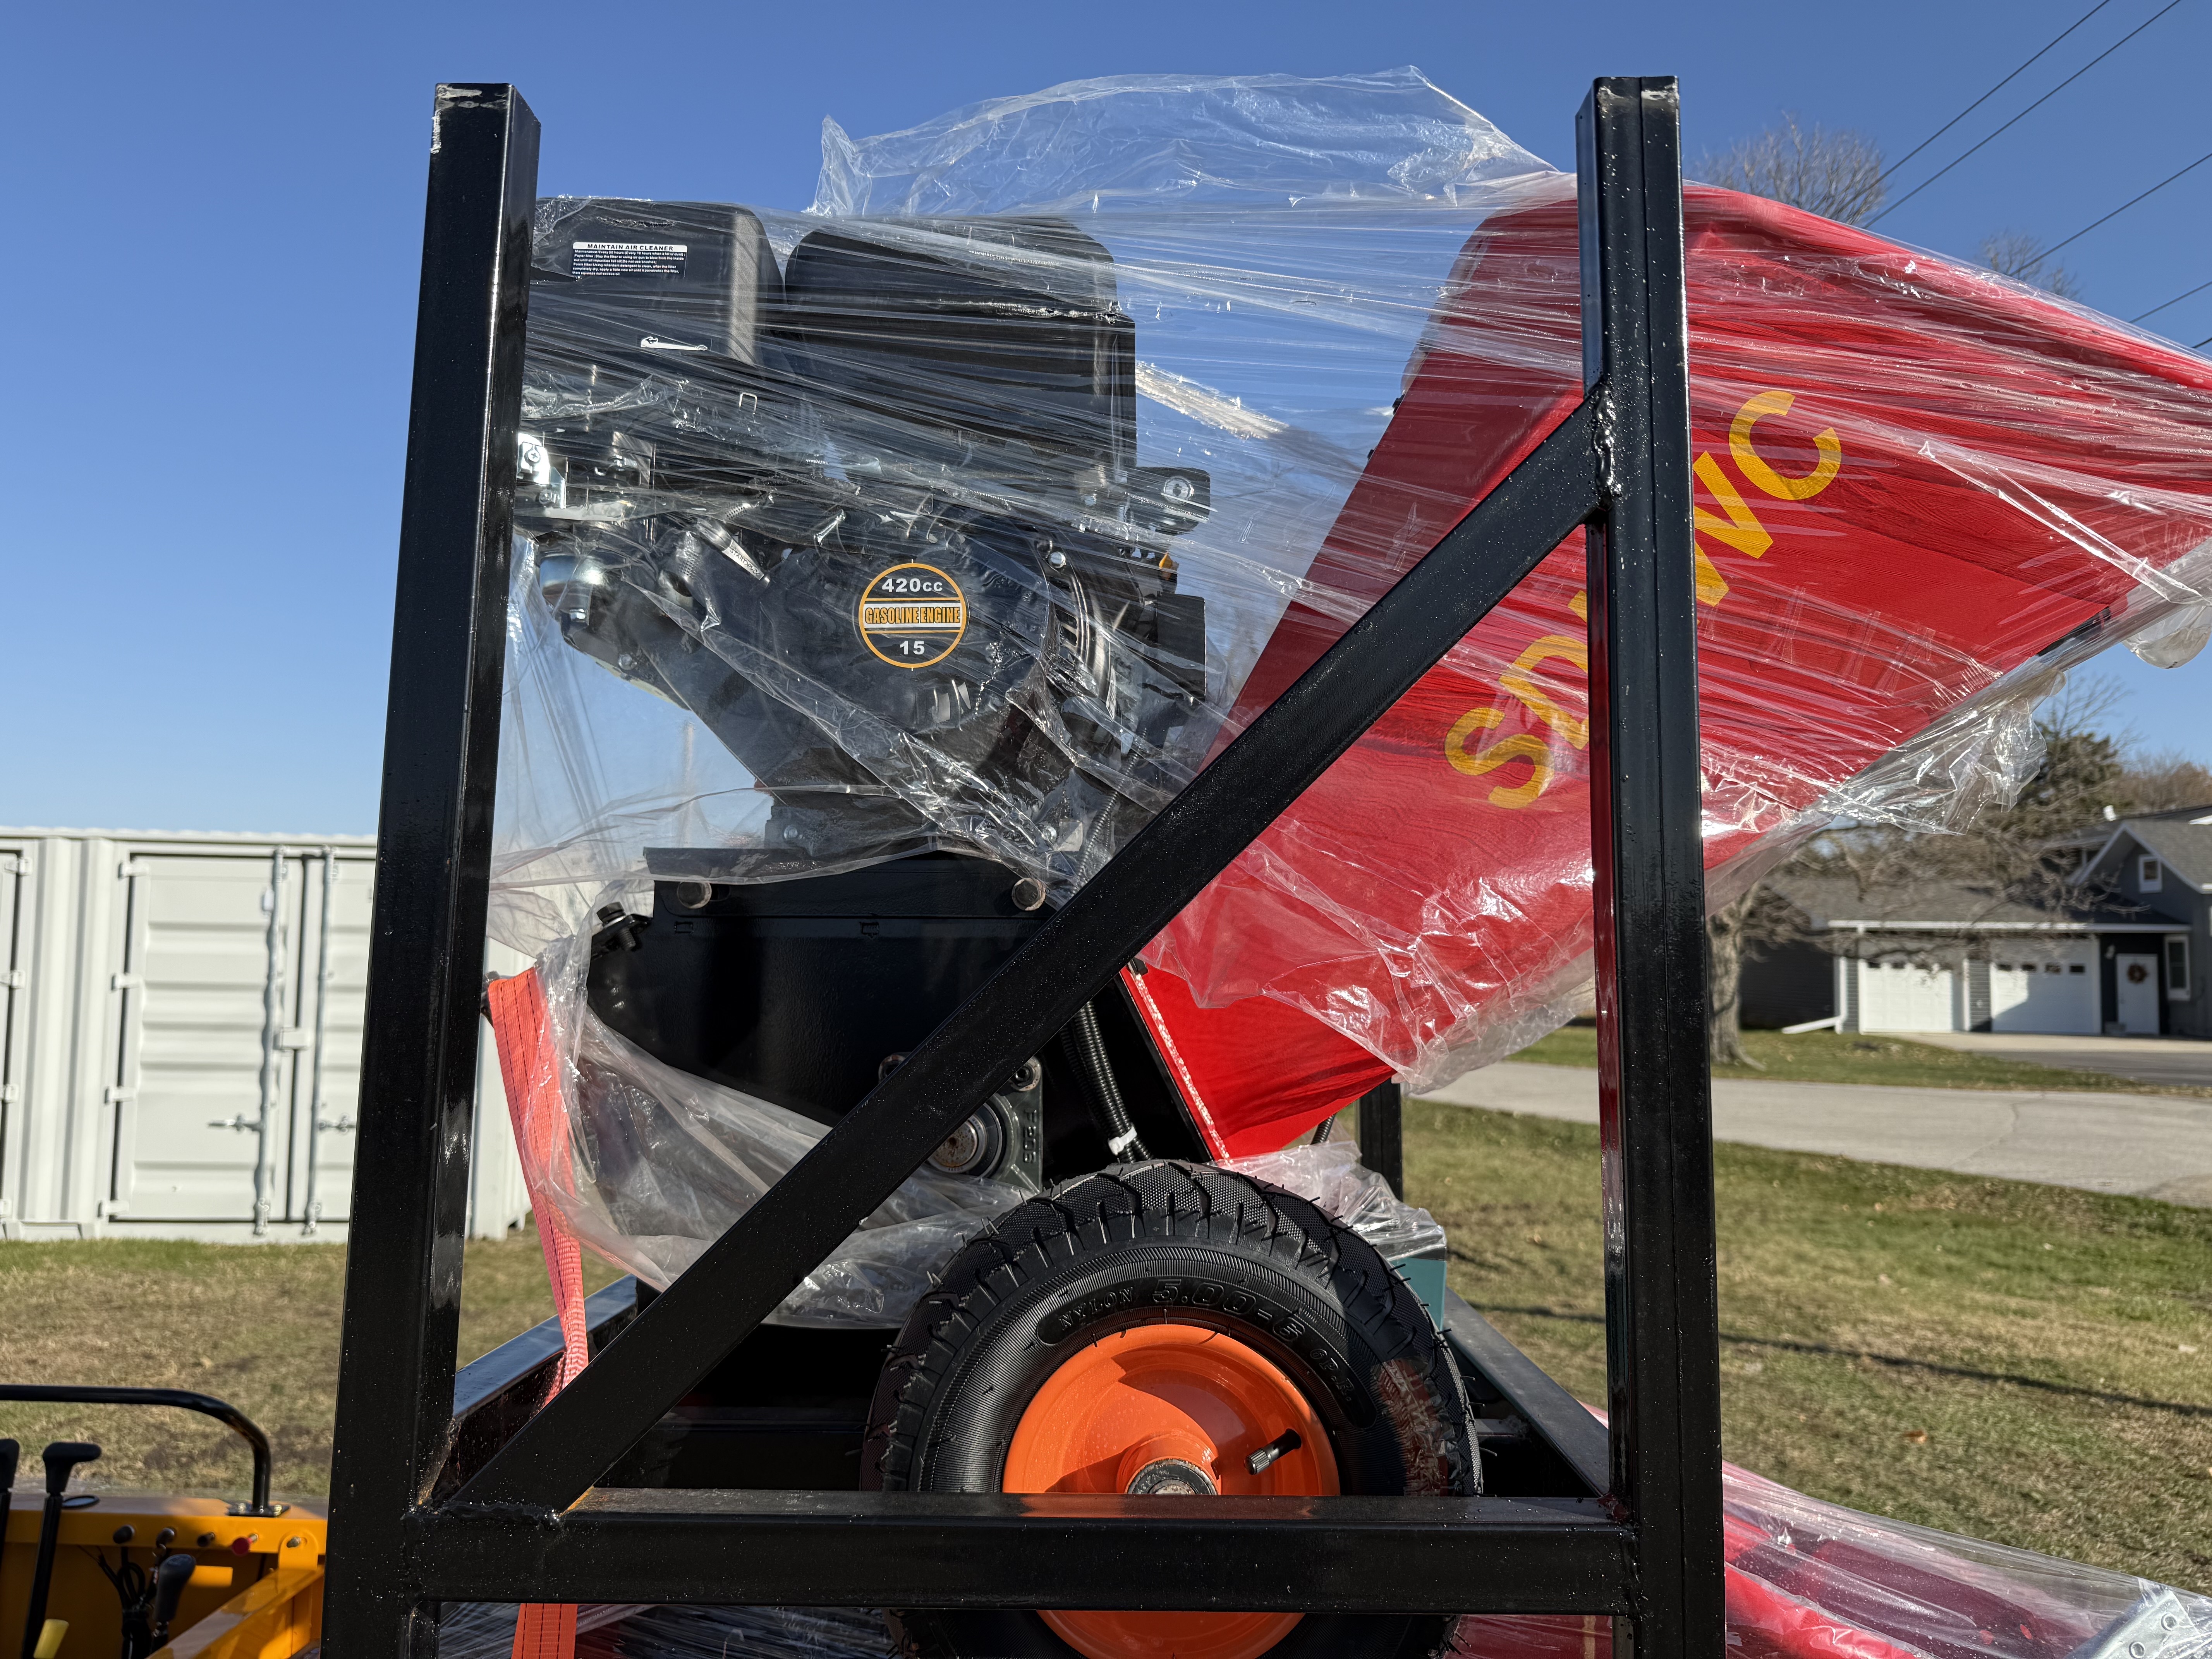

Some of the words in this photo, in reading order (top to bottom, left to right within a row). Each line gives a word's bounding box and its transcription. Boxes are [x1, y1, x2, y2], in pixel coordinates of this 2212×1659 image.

[882, 578, 943, 592] 420cc
[865, 607, 919, 624] GASOLINE
[920, 607, 960, 623] ENGINE
[900, 641, 925, 655] 15
[1058, 1286, 1133, 1331] NYLON
